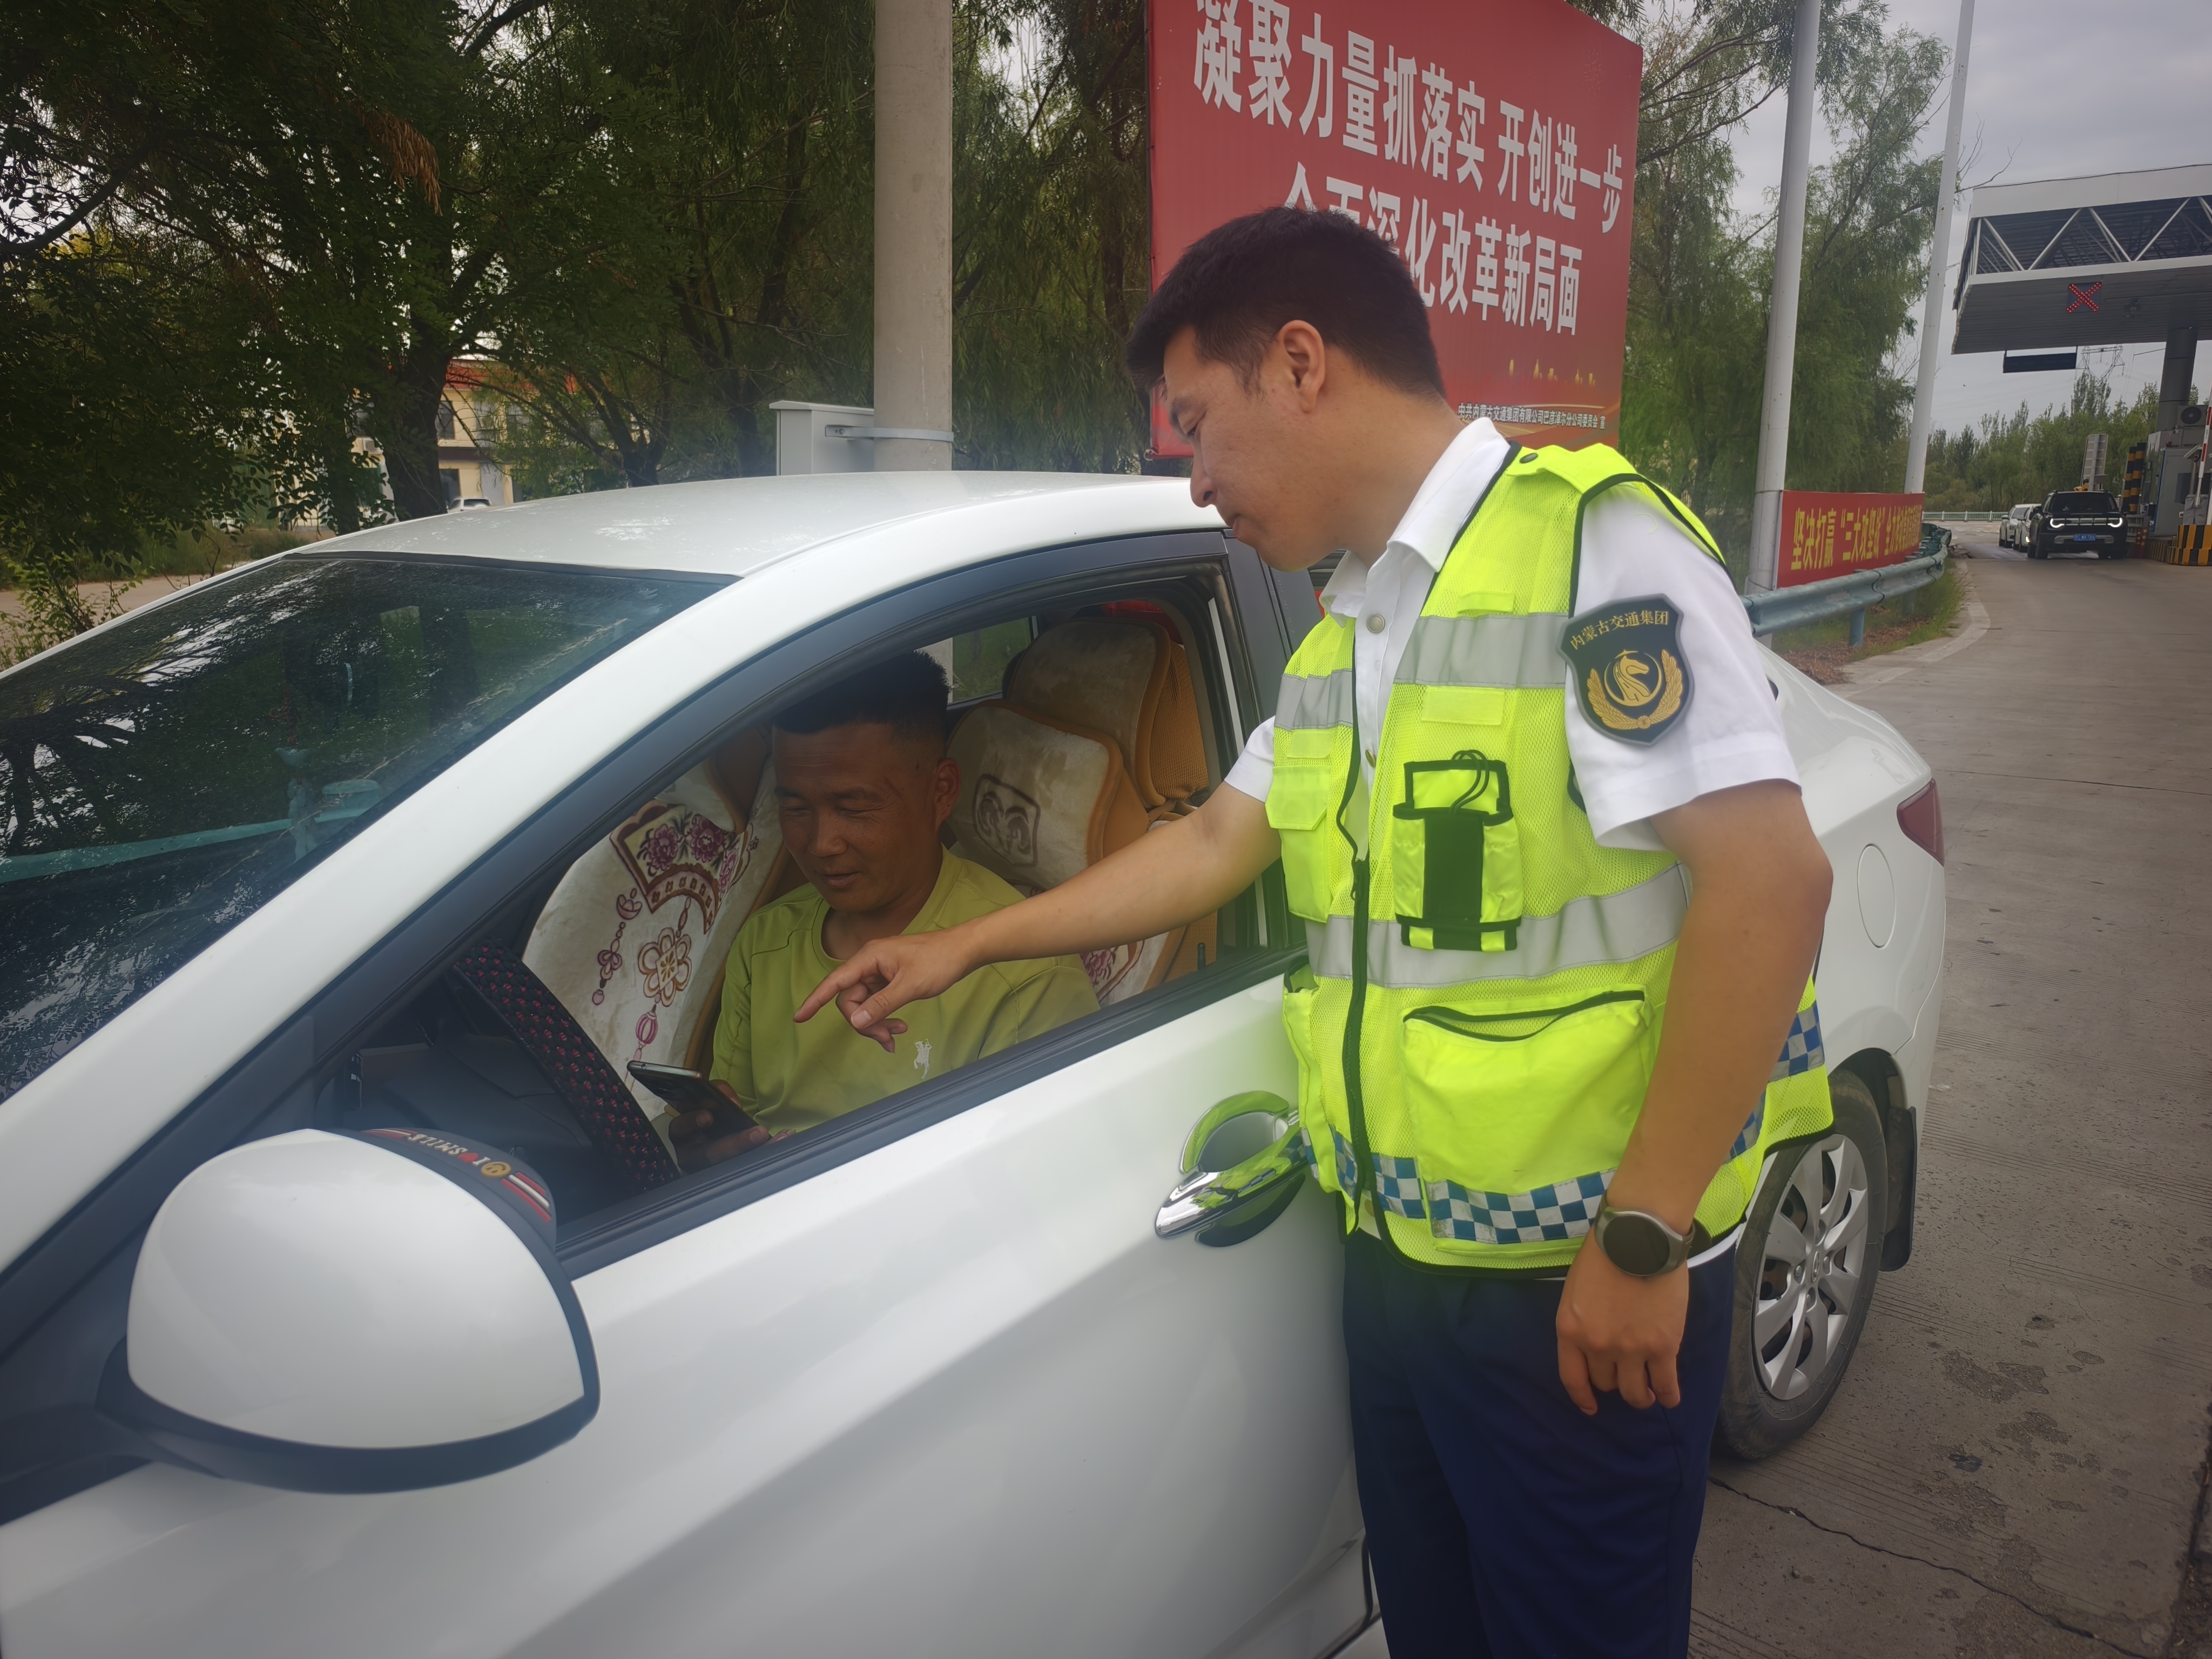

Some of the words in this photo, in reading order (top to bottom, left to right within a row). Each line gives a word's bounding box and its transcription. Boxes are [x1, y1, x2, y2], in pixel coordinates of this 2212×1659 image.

[1193, 0, 1486, 192] 凝聚力量抓落实
[1497, 99, 1623, 234] 开创进一步
[1570, 610, 1669, 650] 内蒙古交通集团
